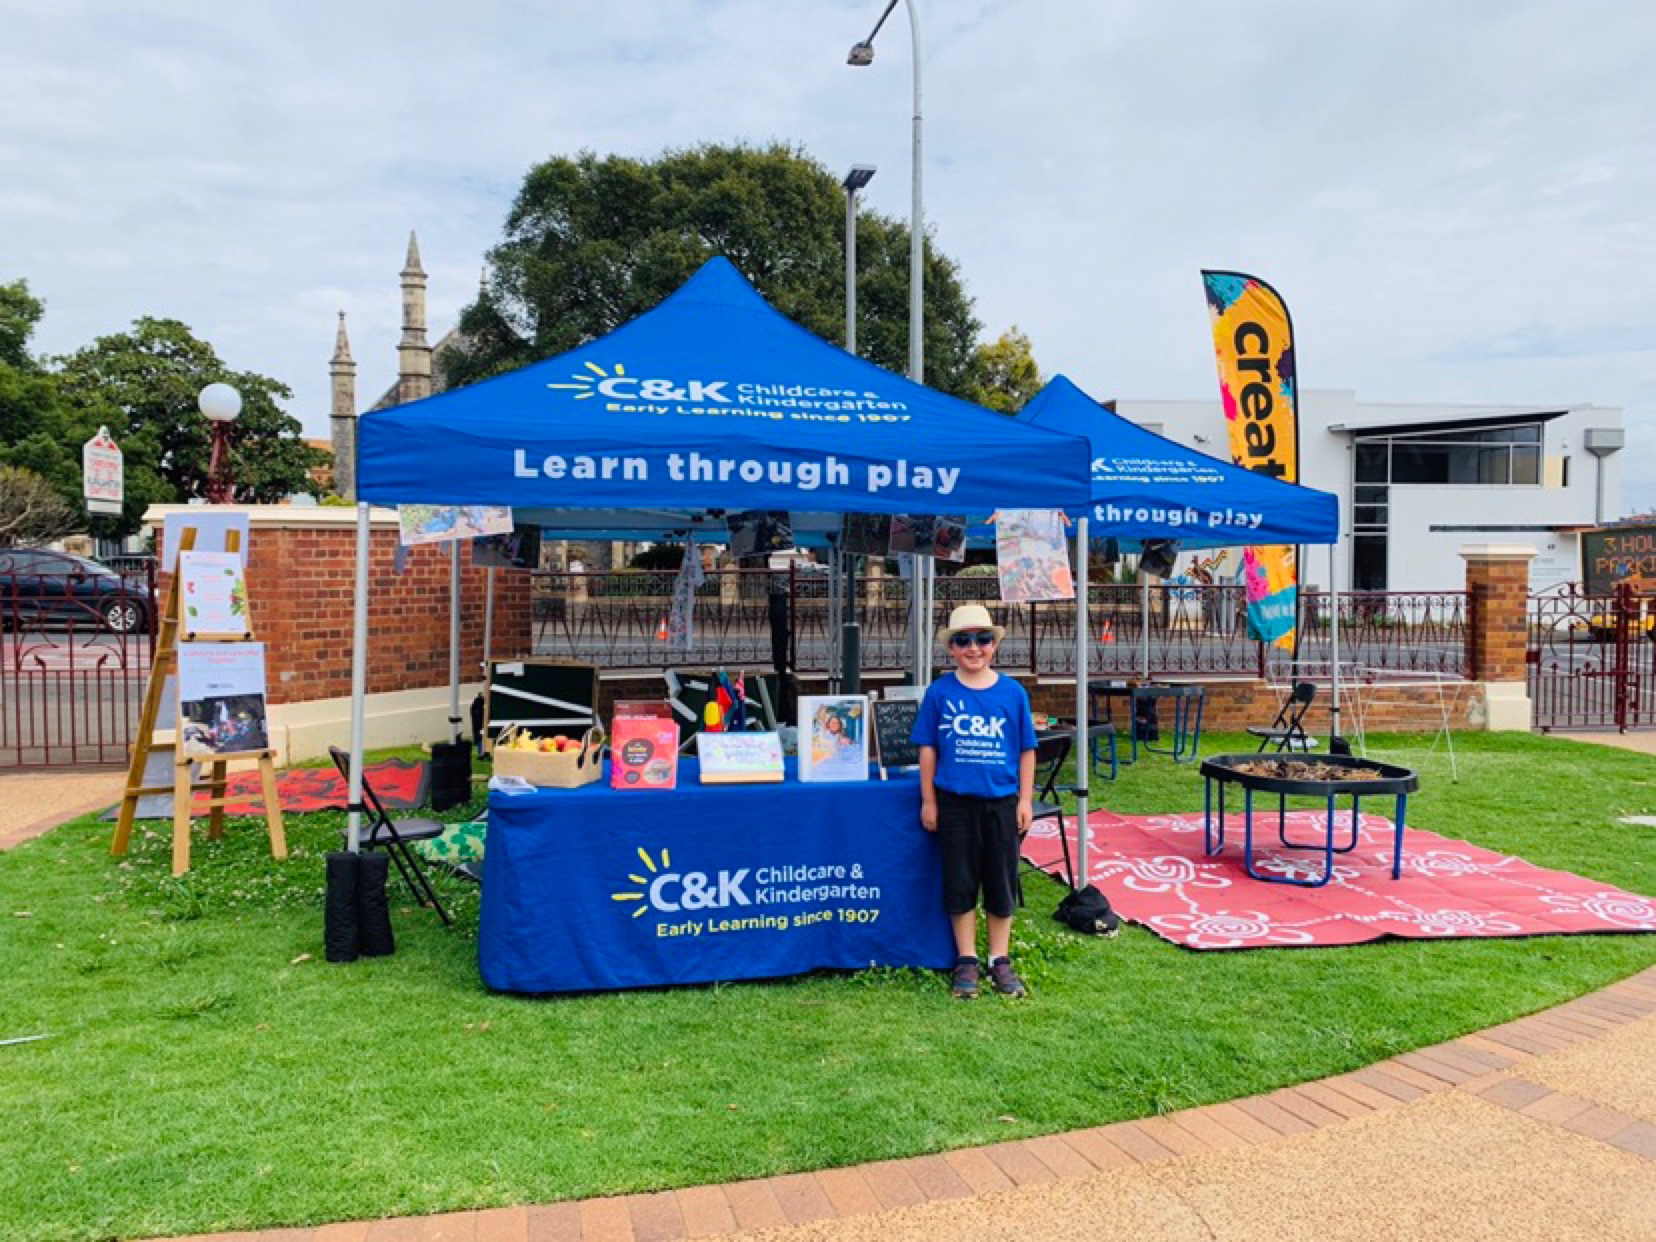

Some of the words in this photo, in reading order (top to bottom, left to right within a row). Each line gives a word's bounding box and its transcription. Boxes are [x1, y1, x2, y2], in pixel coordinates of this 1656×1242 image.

[597, 377, 732, 402] C&K
[736, 383, 856, 397] Childcare
[864, 390, 879, 399] &
[606, 403, 668, 415] Early
[676, 405, 784, 420] Learning
[790, 412, 850, 422] since
[857, 413, 911, 423] 1907
[738, 394, 907, 411] Kindergarten
[514, 448, 649, 483] Learn
[668, 451, 852, 491] through
[867, 459, 962, 496] play
[1094, 503, 1198, 527] through
[1208, 507, 1263, 529] play
[1603, 536, 1617, 555] 3
[953, 714, 1007, 739] C&K
[756, 865, 846, 884] Childcare
[850, 863, 864, 879] &
[649, 868, 752, 912] C&K
[755, 884, 881, 905] Kindergarten
[656, 921, 703, 937] Early
[708, 914, 788, 933] Learning
[793, 909, 833, 927] since
[837, 907, 880, 923] 1907
